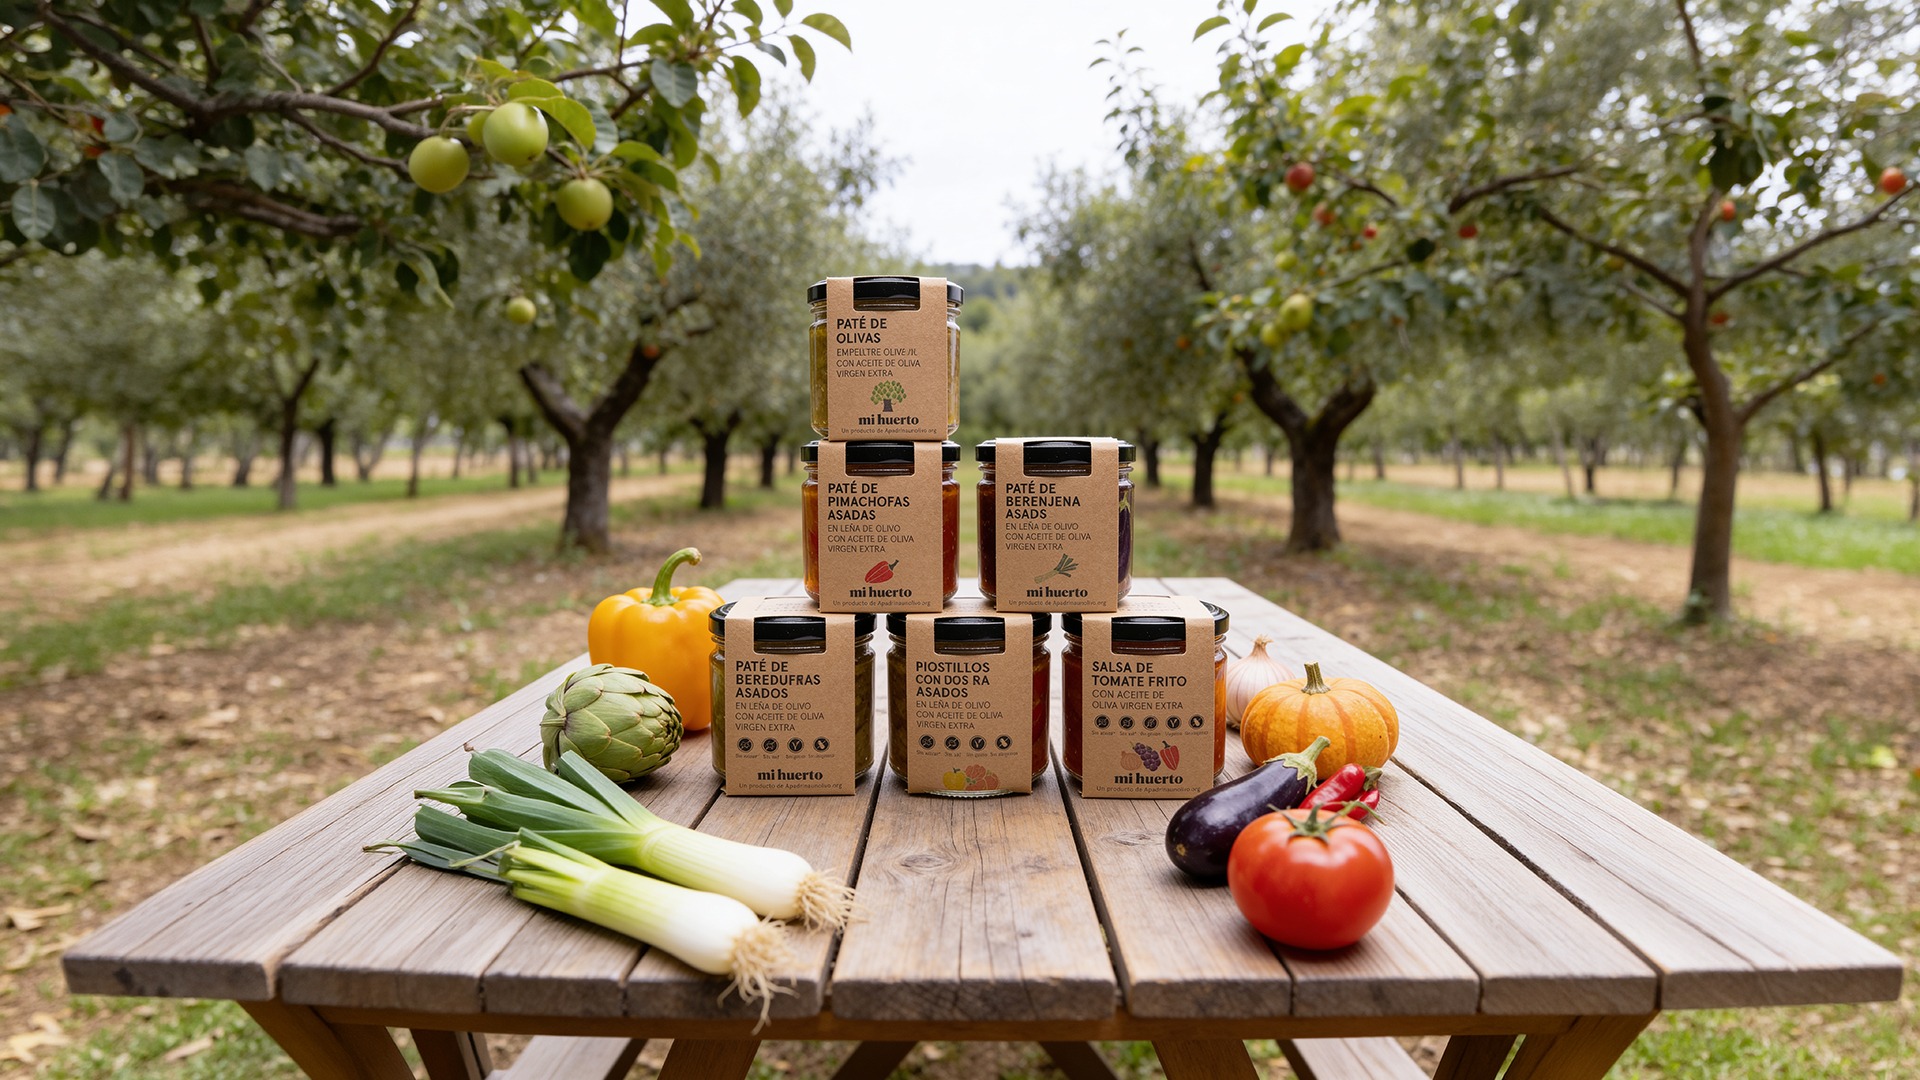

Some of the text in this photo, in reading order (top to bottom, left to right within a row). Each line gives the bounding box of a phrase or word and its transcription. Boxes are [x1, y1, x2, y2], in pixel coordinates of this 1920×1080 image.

[837, 316, 887, 329] PATÉ DE
[836, 333, 881, 344] OLIVAS
[856, 359, 883, 367] ACEITE
[898, 359, 921, 367] OLIVA
[836, 370, 866, 378] VIRGEN
[858, 414, 919, 425] mi huerto
[828, 480, 878, 494] PATÉ DE
[1006, 480, 1056, 494] PATÉ DE
[828, 496, 910, 507] PIMACHOFAS
[1006, 496, 1080, 507] BERENJENA
[827, 510, 876, 520] ASADAS
[1005, 509, 1047, 519] ASADS
[840, 524, 860, 532] LEÑA
[875, 525, 900, 533] OLIVO
[1019, 522, 1039, 530] LEÑA
[828, 545, 857, 553] VIRGEN
[850, 587, 912, 597] mi huerto
[1027, 587, 1088, 597] mi huerto
[736, 659, 788, 672] PATÉ DE
[916, 661, 990, 673] PIOSTILLOS
[1092, 661, 1153, 673] SALSA DE
[736, 675, 821, 685] BEREDUFRAS
[916, 675, 990, 686] CON DOS RA
[1092, 675, 1187, 687] TOMATE FRITO
[735, 688, 789, 699] ASADOS
[916, 687, 968, 698] ASADOS
[1092, 690, 1165, 699] CON ACEITE DE
[736, 701, 811, 710] EN LEÑA DE OLIVO
[929, 700, 950, 709] LEÑA
[965, 701, 991, 709] OLIVO
[1092, 701, 1183, 710] OLIVA VIRGEN EXTRA
[756, 713, 784, 721] ACEITE
[787, 713, 798, 721] DE
[916, 711, 934, 719] CON
[936, 711, 964, 719] ACEITE
[980, 711, 1003, 719] OLIVA
[735, 723, 766, 731] VIRGEN
[916, 721, 975, 730] VIRGEN EXTRA
[757, 769, 823, 781] mi huerto
[1114, 773, 1183, 784] mi huerto
